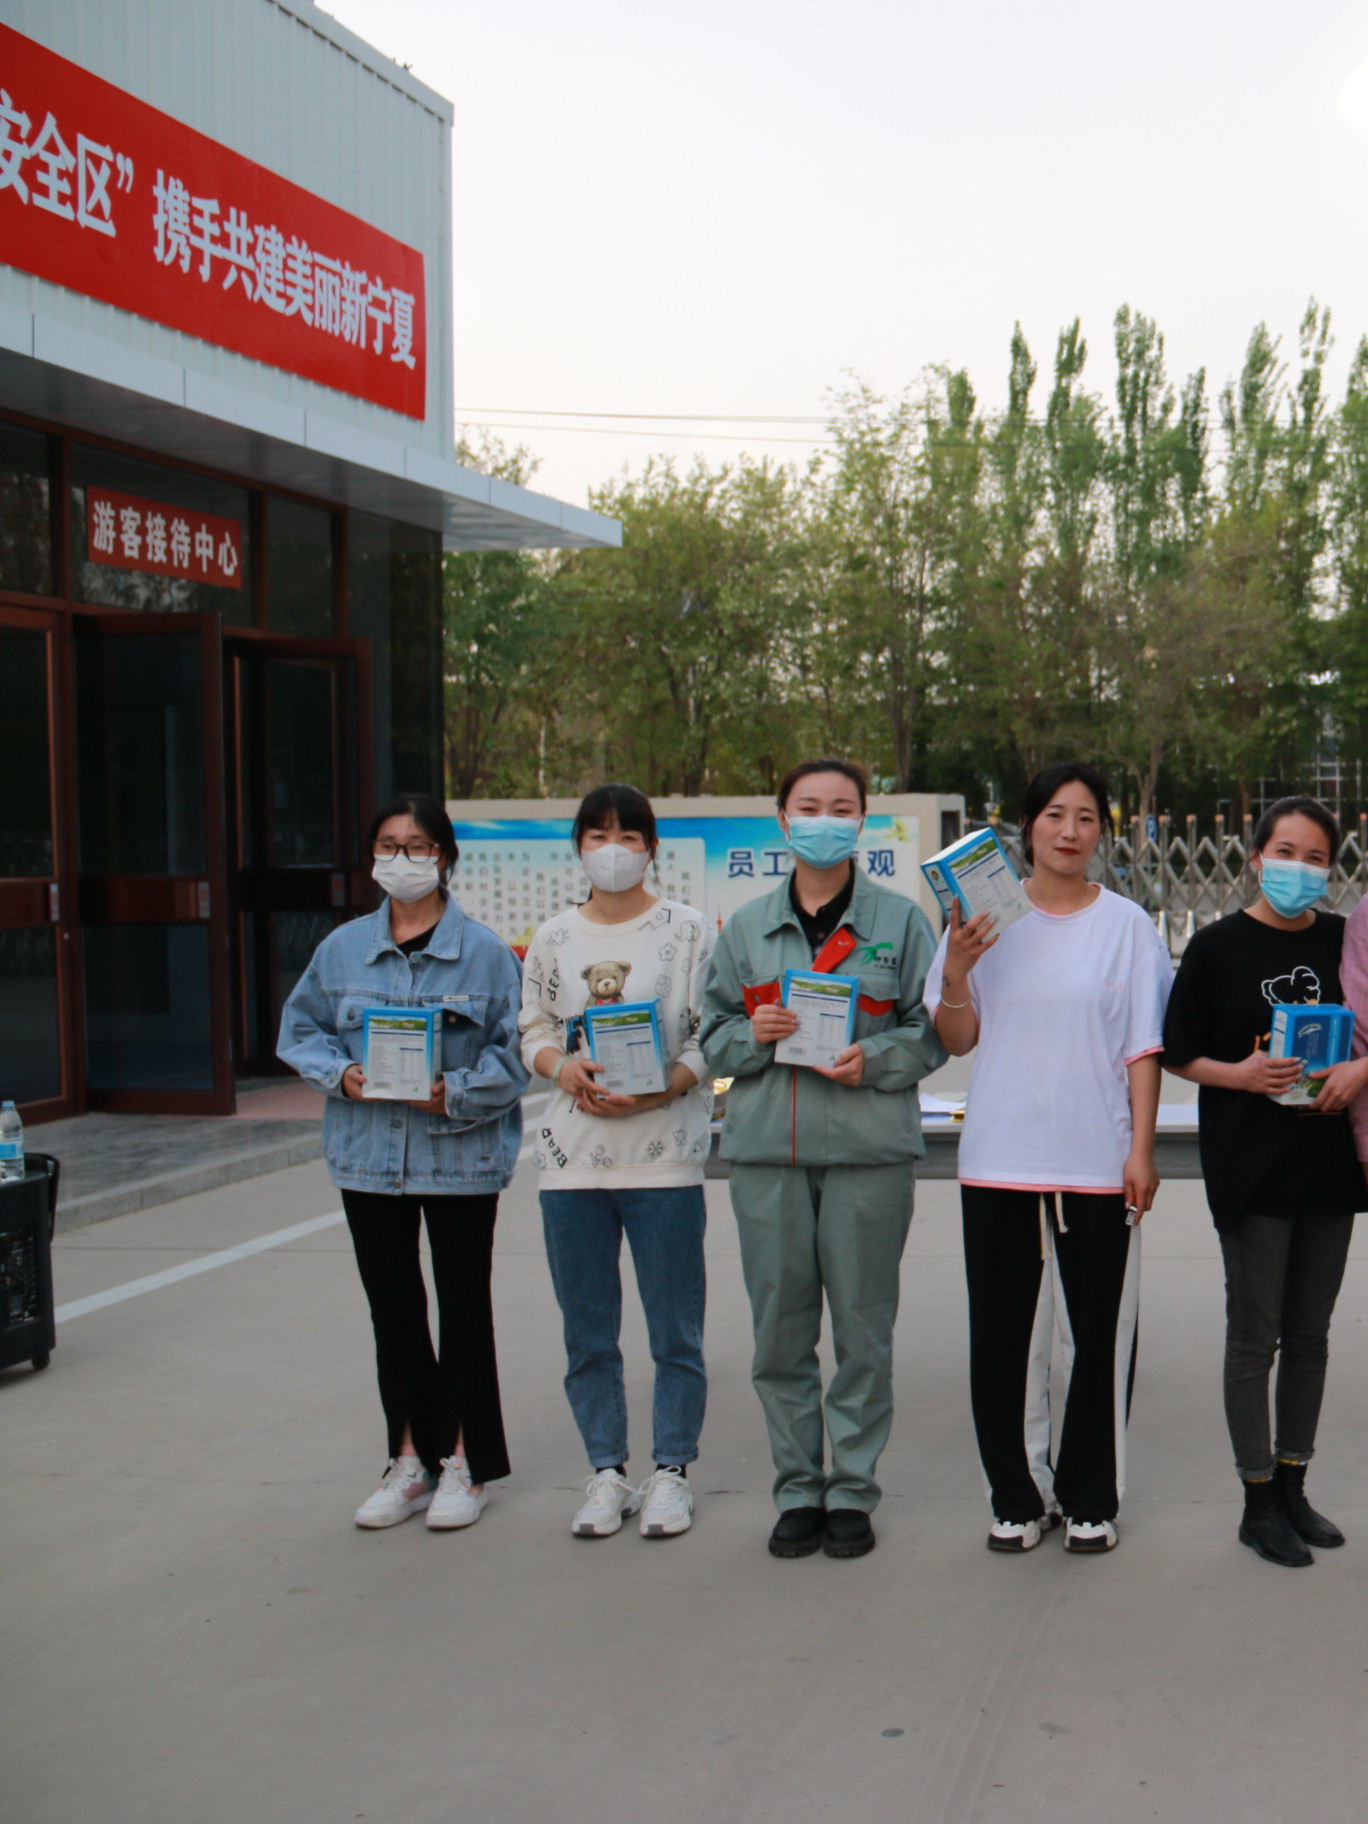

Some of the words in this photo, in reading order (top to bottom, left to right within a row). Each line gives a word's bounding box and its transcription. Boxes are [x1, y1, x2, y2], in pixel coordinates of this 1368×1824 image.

[153, 169, 416, 370] 携手共建美丽新宁夏
[93, 500, 238, 576] 游客接待中心
